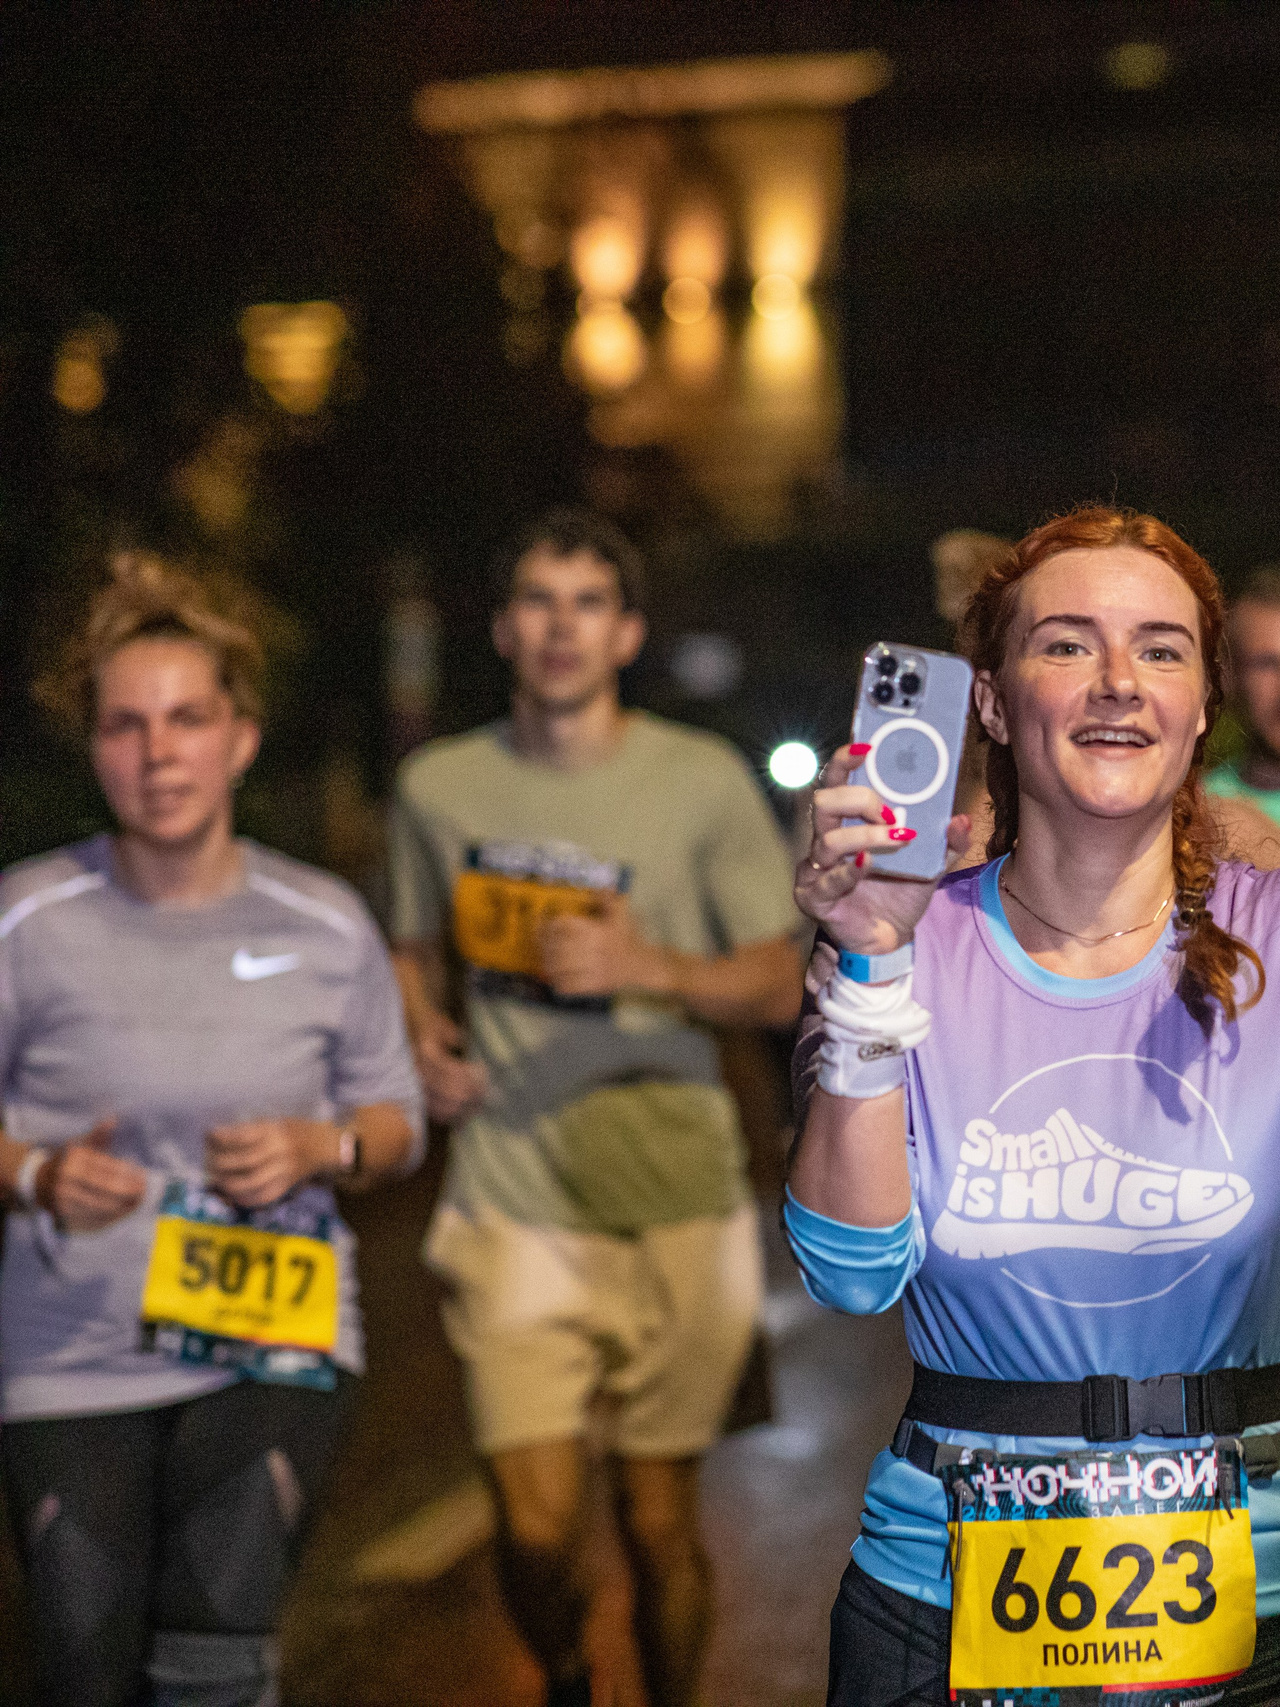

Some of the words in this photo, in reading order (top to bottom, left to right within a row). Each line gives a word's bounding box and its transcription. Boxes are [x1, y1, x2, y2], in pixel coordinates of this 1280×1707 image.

[960, 1107, 1096, 1171] Small
[947, 1163, 996, 1218] is
[1000, 1158, 1240, 1227] HUGE
[178, 1231, 317, 1306] 5017
[972, 1450, 1219, 1506] НОЧНОЙ
[1090, 1499, 1185, 1518] ЗАБЕГ
[991, 1539, 1218, 1633] 6623
[1042, 1639, 1163, 1667] ПОЛИНА
